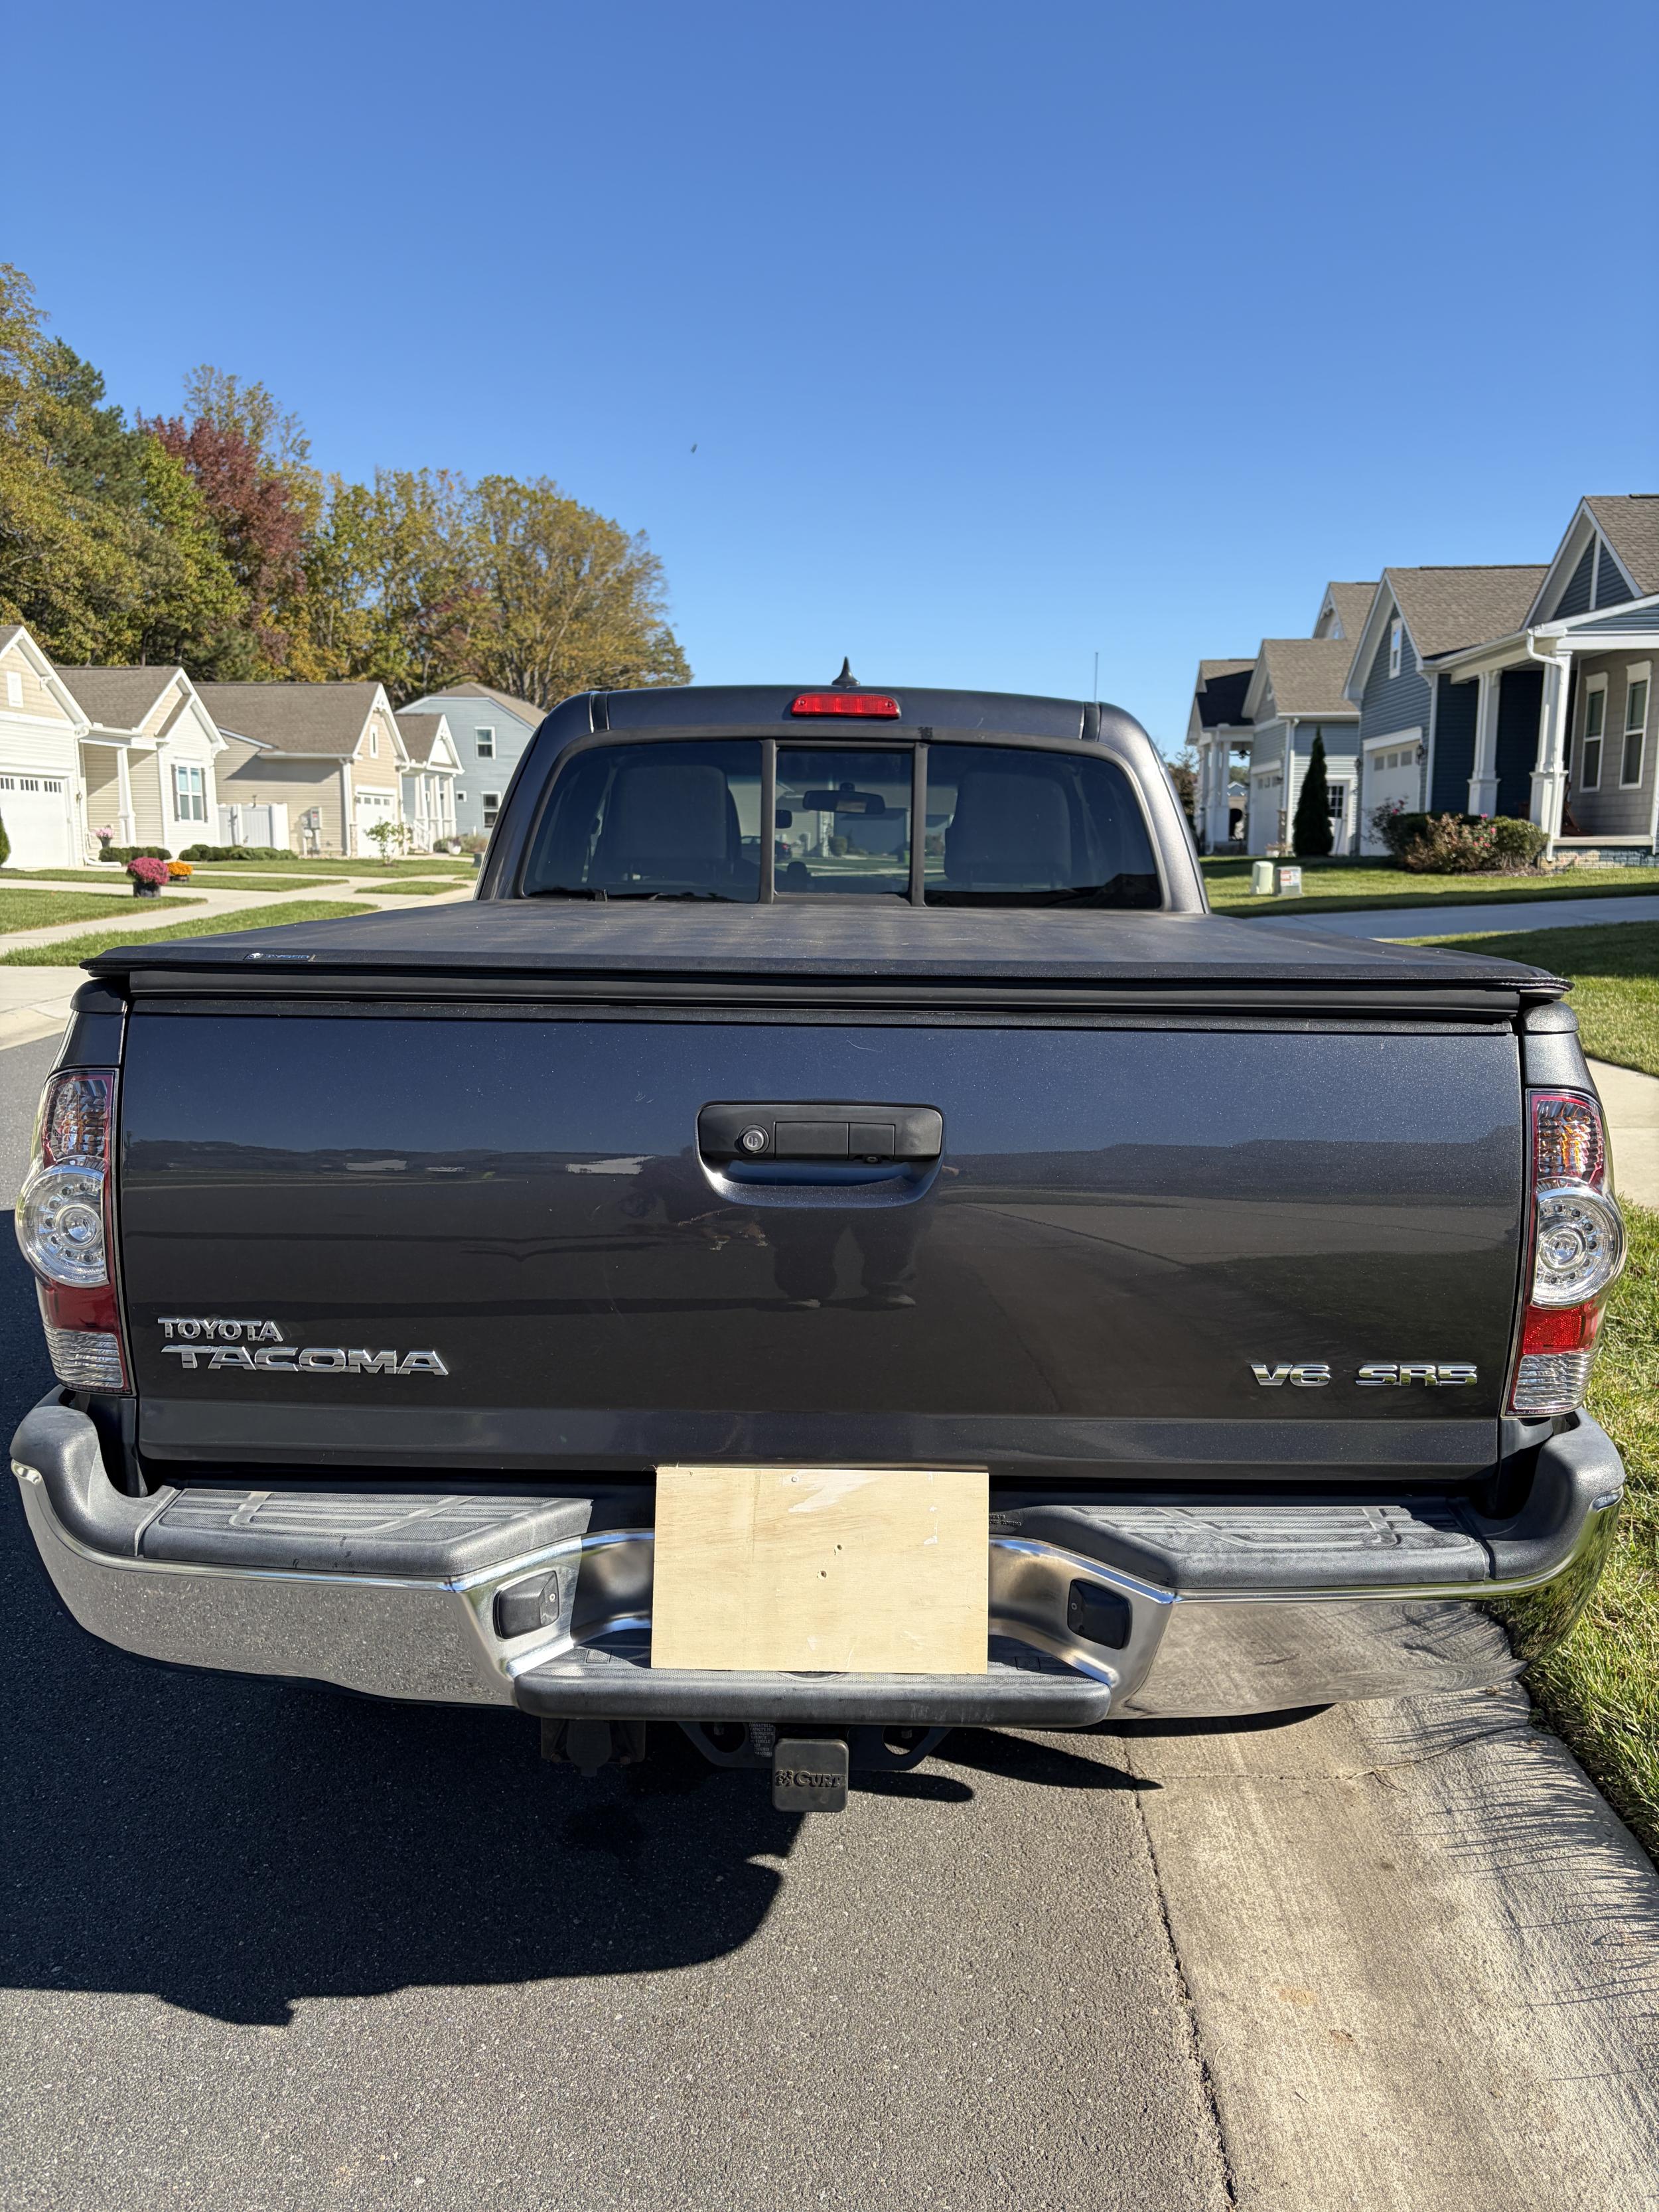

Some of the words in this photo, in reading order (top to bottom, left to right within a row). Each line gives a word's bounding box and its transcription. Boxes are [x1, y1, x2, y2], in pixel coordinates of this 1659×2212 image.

[157, 1317, 283, 1342] TOYOTA
[161, 1345, 449, 1375] TACOMA
[1250, 1364, 1332, 1386] V6
[1355, 1364, 1477, 1386] SR5
[794, 1771, 843, 1787] CURT
